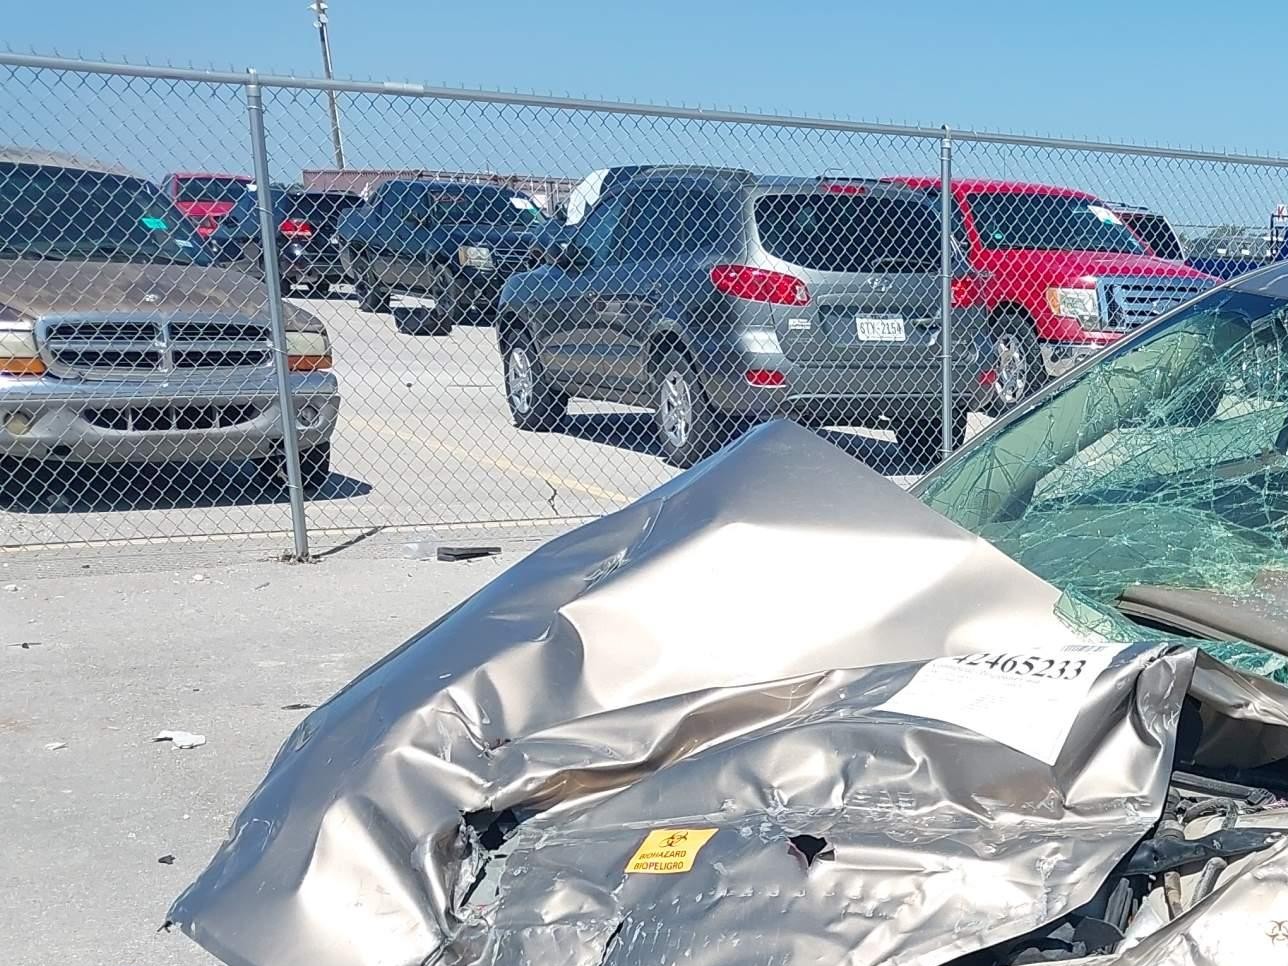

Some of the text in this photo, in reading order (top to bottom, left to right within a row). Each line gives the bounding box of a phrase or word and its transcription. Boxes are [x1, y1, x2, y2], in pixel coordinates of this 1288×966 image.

[953, 652, 1087, 679] 42465233
[639, 850, 686, 860] BIOHAZARD
[634, 862, 684, 870] BIOPELIGRO
